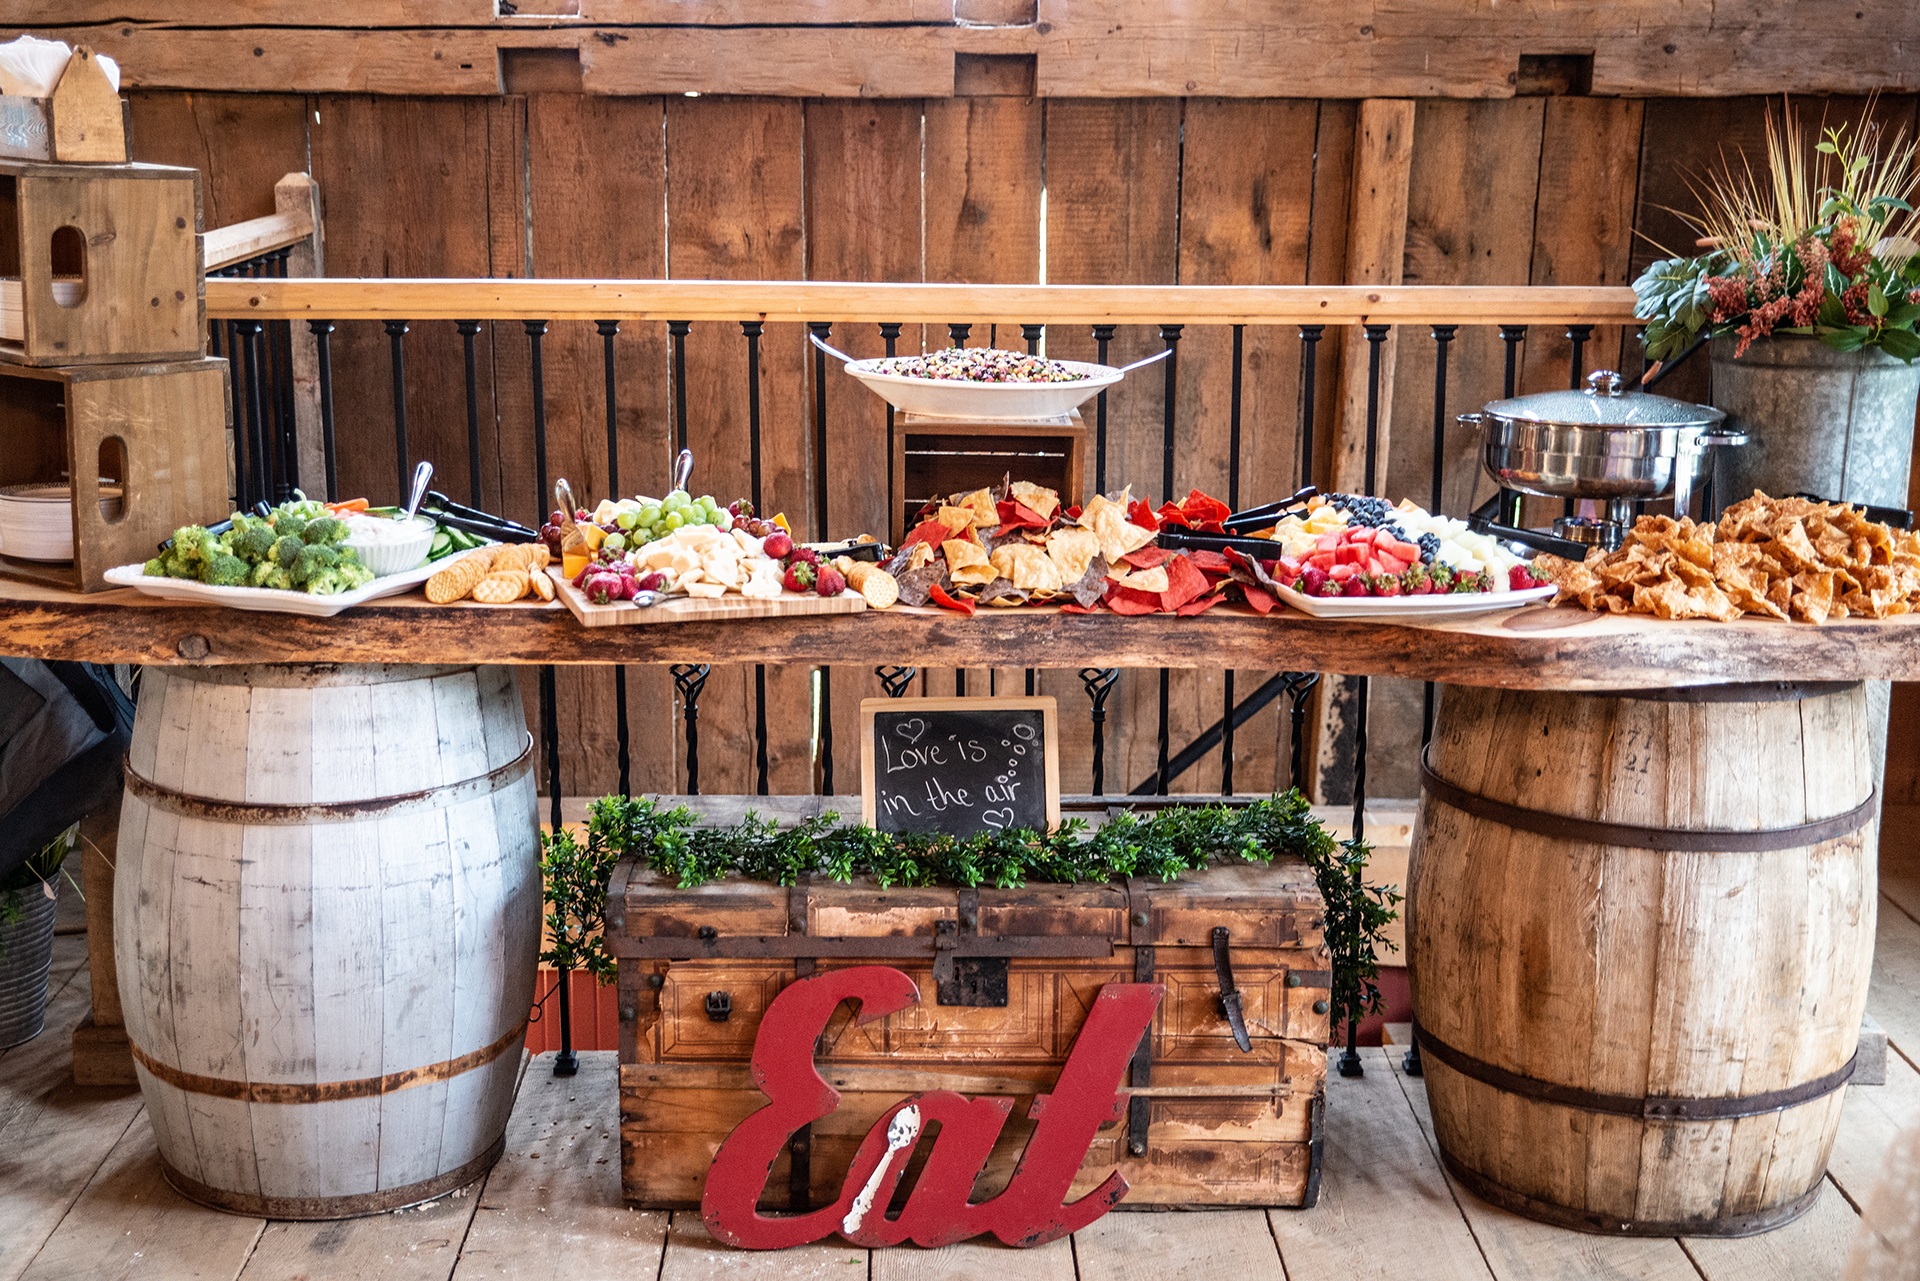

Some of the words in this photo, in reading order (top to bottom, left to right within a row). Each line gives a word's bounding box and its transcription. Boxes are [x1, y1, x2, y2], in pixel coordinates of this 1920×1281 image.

[881, 735, 948, 773] Love
[949, 734, 987, 762] is
[881, 789, 921, 816] in
[925, 777, 974, 811] the
[985, 775, 1021, 803] air
[701, 965, 1167, 1249] Eat
